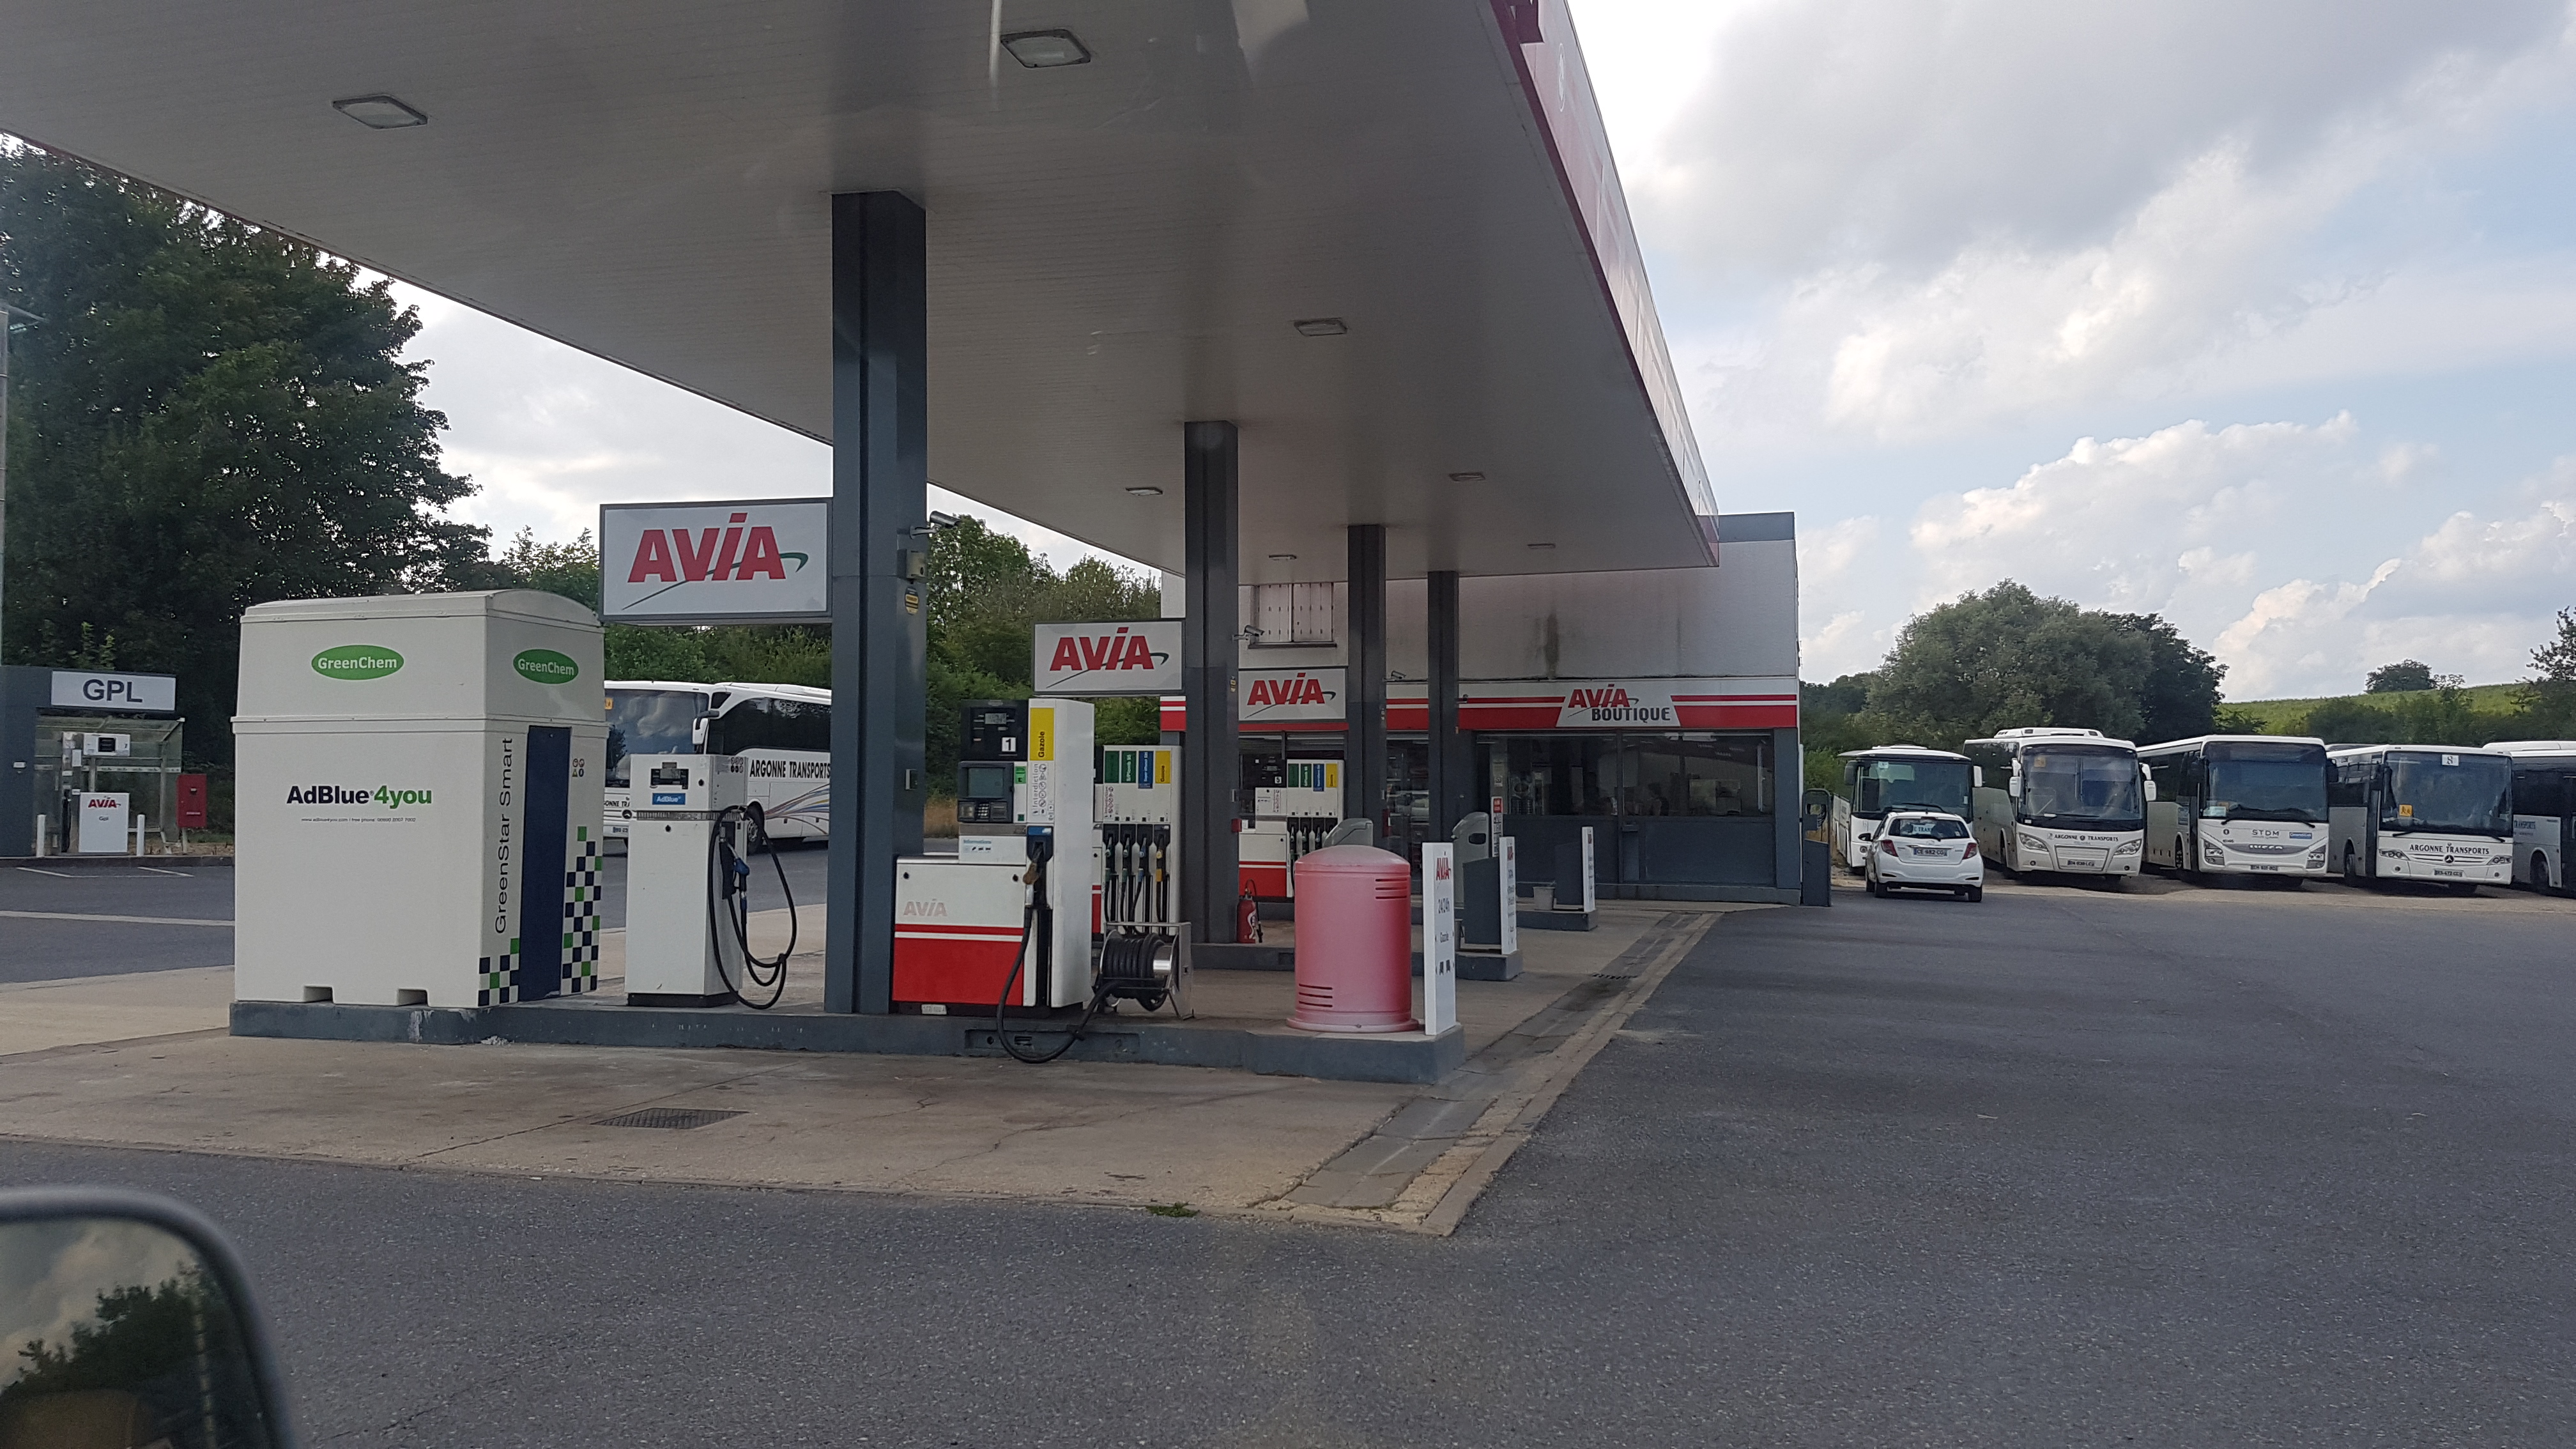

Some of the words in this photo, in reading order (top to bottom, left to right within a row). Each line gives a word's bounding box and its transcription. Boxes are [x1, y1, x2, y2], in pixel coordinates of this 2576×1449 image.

[318, 656, 397, 669] GreenChem
[518, 659, 574, 676] GreenChem
[82, 678, 143, 703] GPL
[1591, 707, 1671, 723] BOUTIQUE
[1005, 739, 1012, 751] 1
[500, 738, 512, 806] Smart
[749, 760, 786, 778] ARGONNE
[789, 761, 831, 779] TRANSPORTS
[2410, 844, 2443, 852] ARGONNE
[2446, 846, 2490, 855] TRANSPORTS
[495, 814, 510, 933] GreenStar
